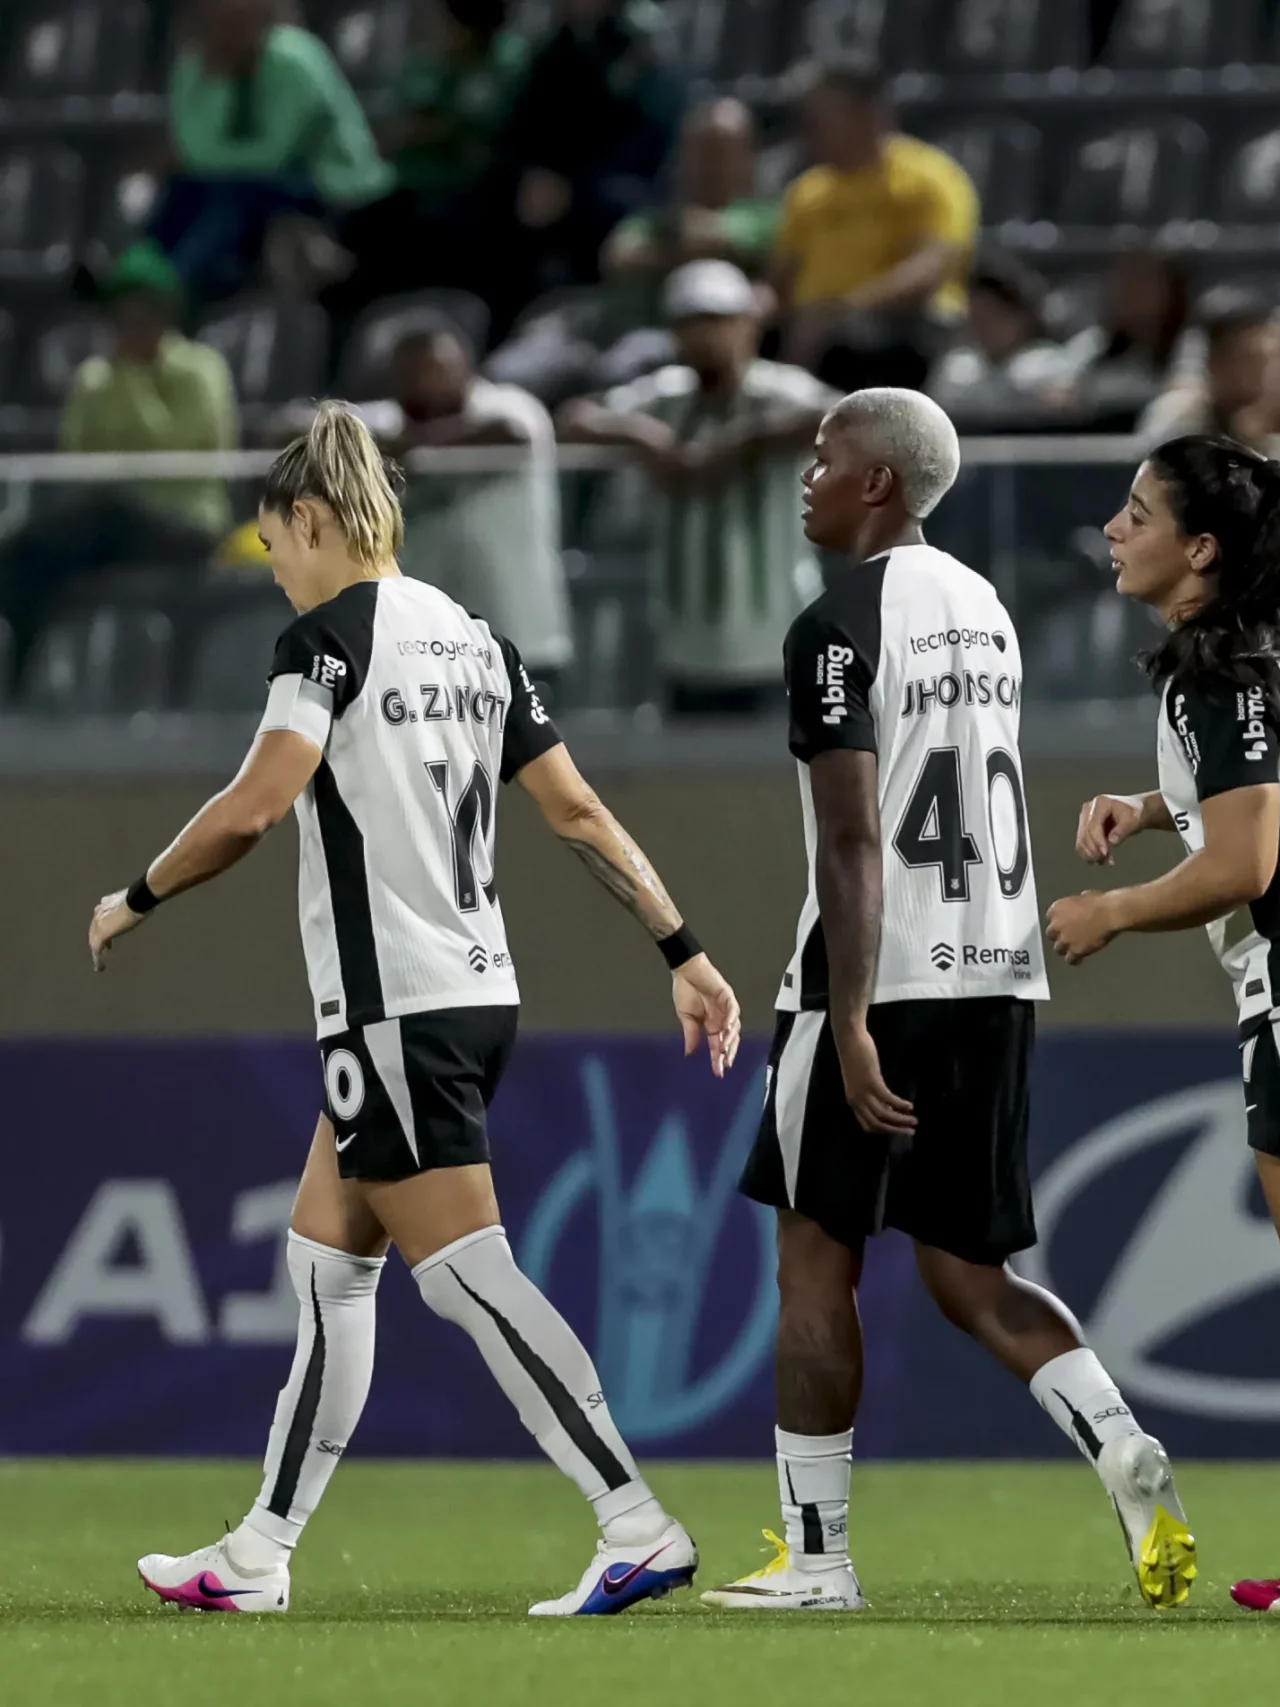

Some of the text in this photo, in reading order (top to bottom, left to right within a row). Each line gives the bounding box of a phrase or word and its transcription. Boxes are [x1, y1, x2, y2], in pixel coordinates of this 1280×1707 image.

[816, 654, 825, 685] banco
[821, 644, 854, 703] bmg
[892, 745, 1029, 903] 40
[323, 1047, 365, 1121] 0
